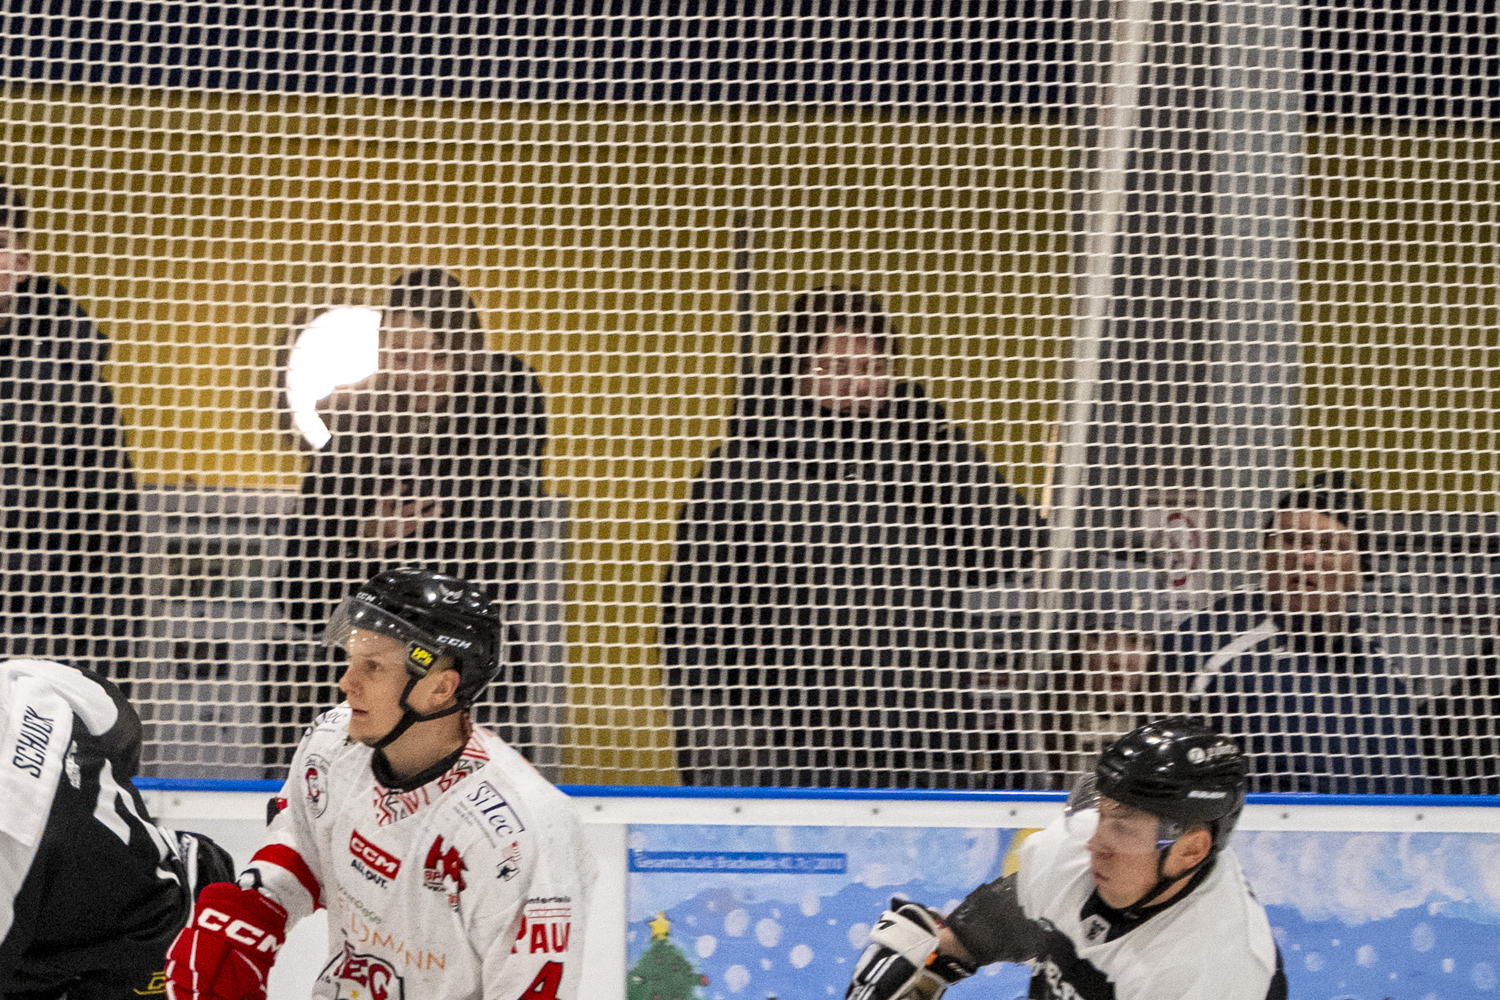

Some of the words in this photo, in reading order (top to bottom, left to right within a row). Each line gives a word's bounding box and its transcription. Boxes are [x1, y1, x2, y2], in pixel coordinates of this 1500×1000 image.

[436, 634, 473, 650] CCM
[12, 704, 55, 779] SCHUCK
[350, 836, 398, 874] CCM
